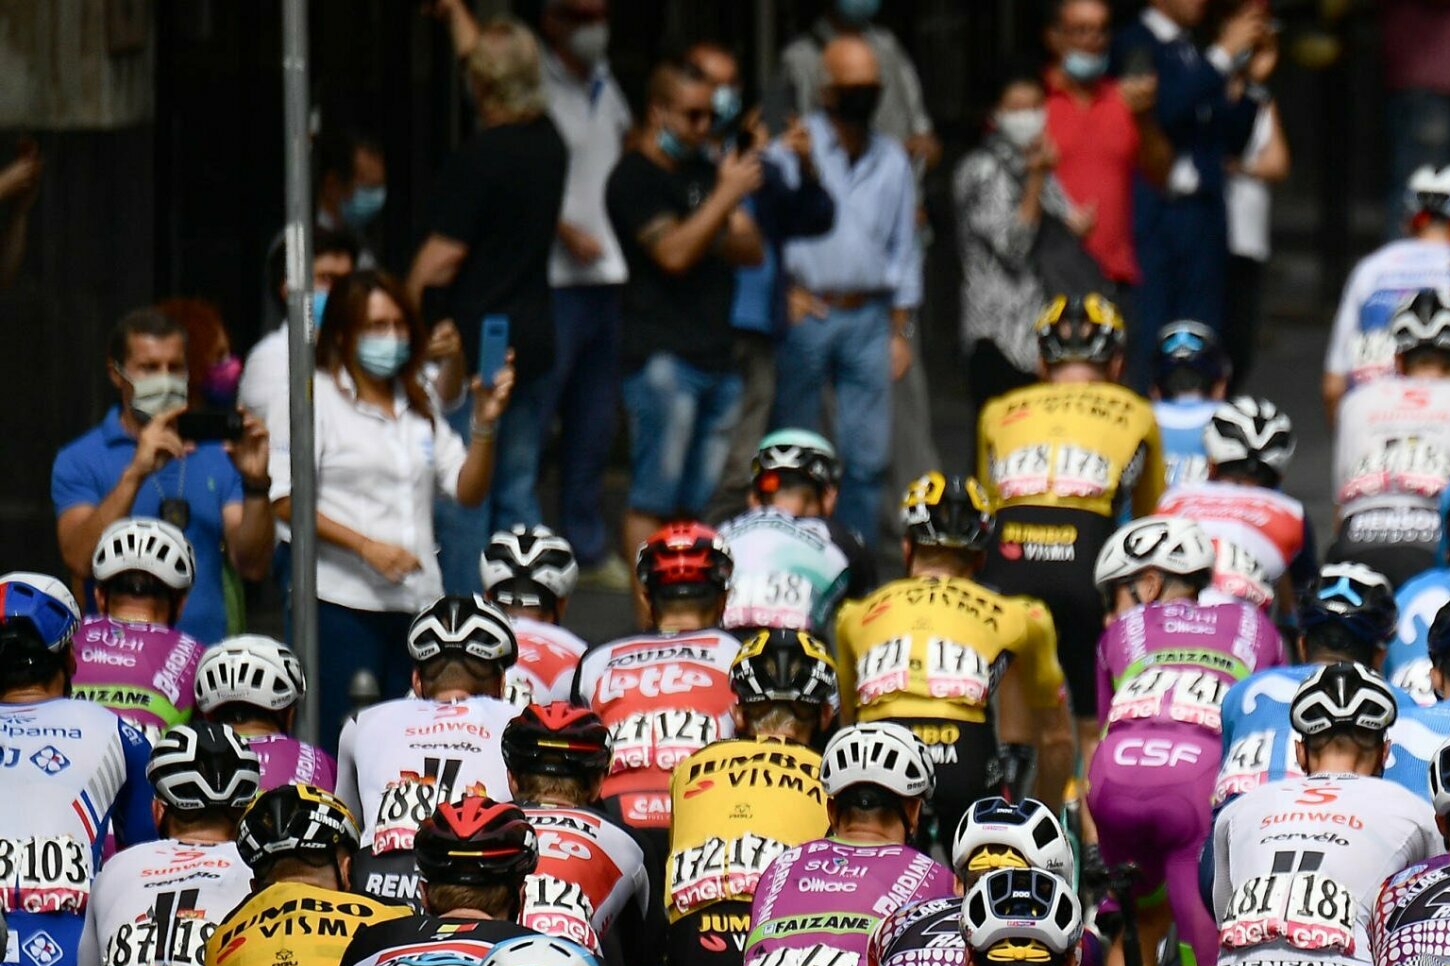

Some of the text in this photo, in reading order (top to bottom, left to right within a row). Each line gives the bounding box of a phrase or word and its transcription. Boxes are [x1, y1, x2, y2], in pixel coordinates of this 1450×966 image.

[405, 721, 491, 740] sunweb
[1114, 738, 1201, 767] CSF
[728, 768, 823, 804] VISMA
[1260, 810, 1364, 831] sunweb
[24, 840, 87, 884] 103
[804, 860, 868, 877] SUHI
[1222, 874, 1277, 923] 181
[1297, 873, 1353, 926] 181
[1398, 869, 1448, 909] PALACE
[217, 897, 375, 953] JUMBO
[259, 914, 372, 939] VISMA
